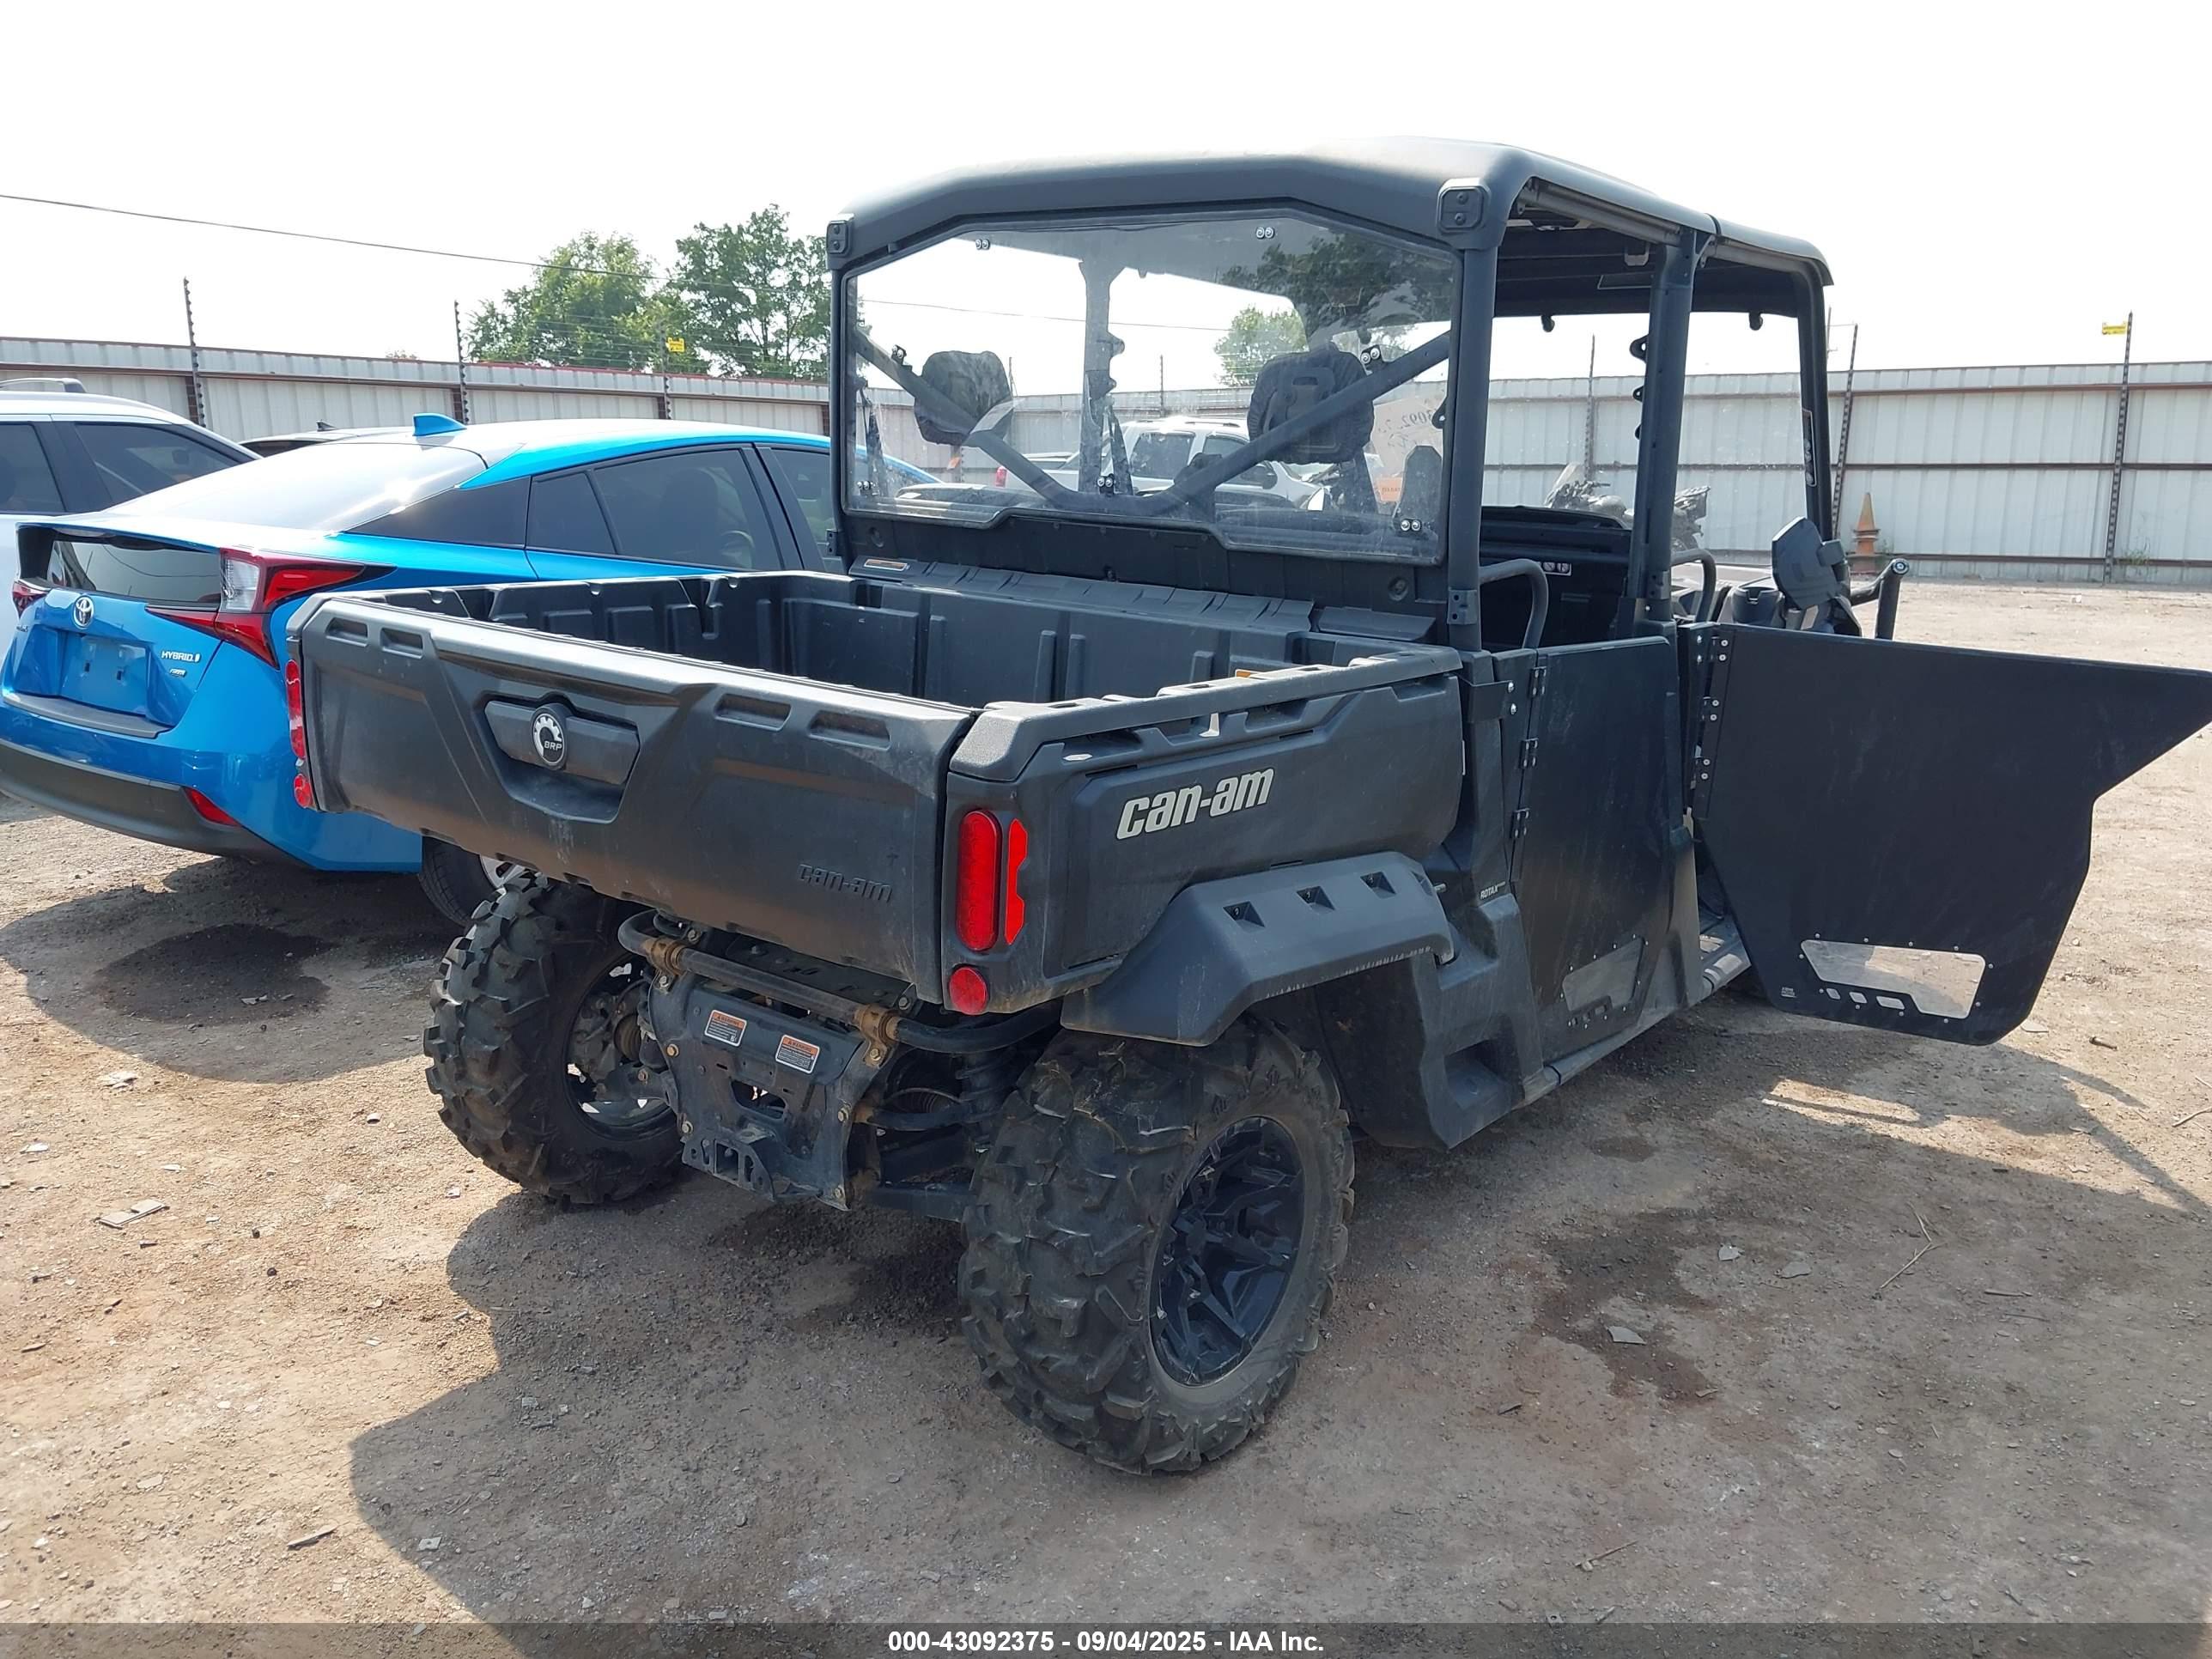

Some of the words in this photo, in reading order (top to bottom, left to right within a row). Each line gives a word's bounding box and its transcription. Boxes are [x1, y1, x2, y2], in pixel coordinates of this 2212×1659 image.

[161, 650, 195, 662] HYBRID
[544, 741, 562, 751] BRP
[1480, 884, 1498, 900] ROTAX
